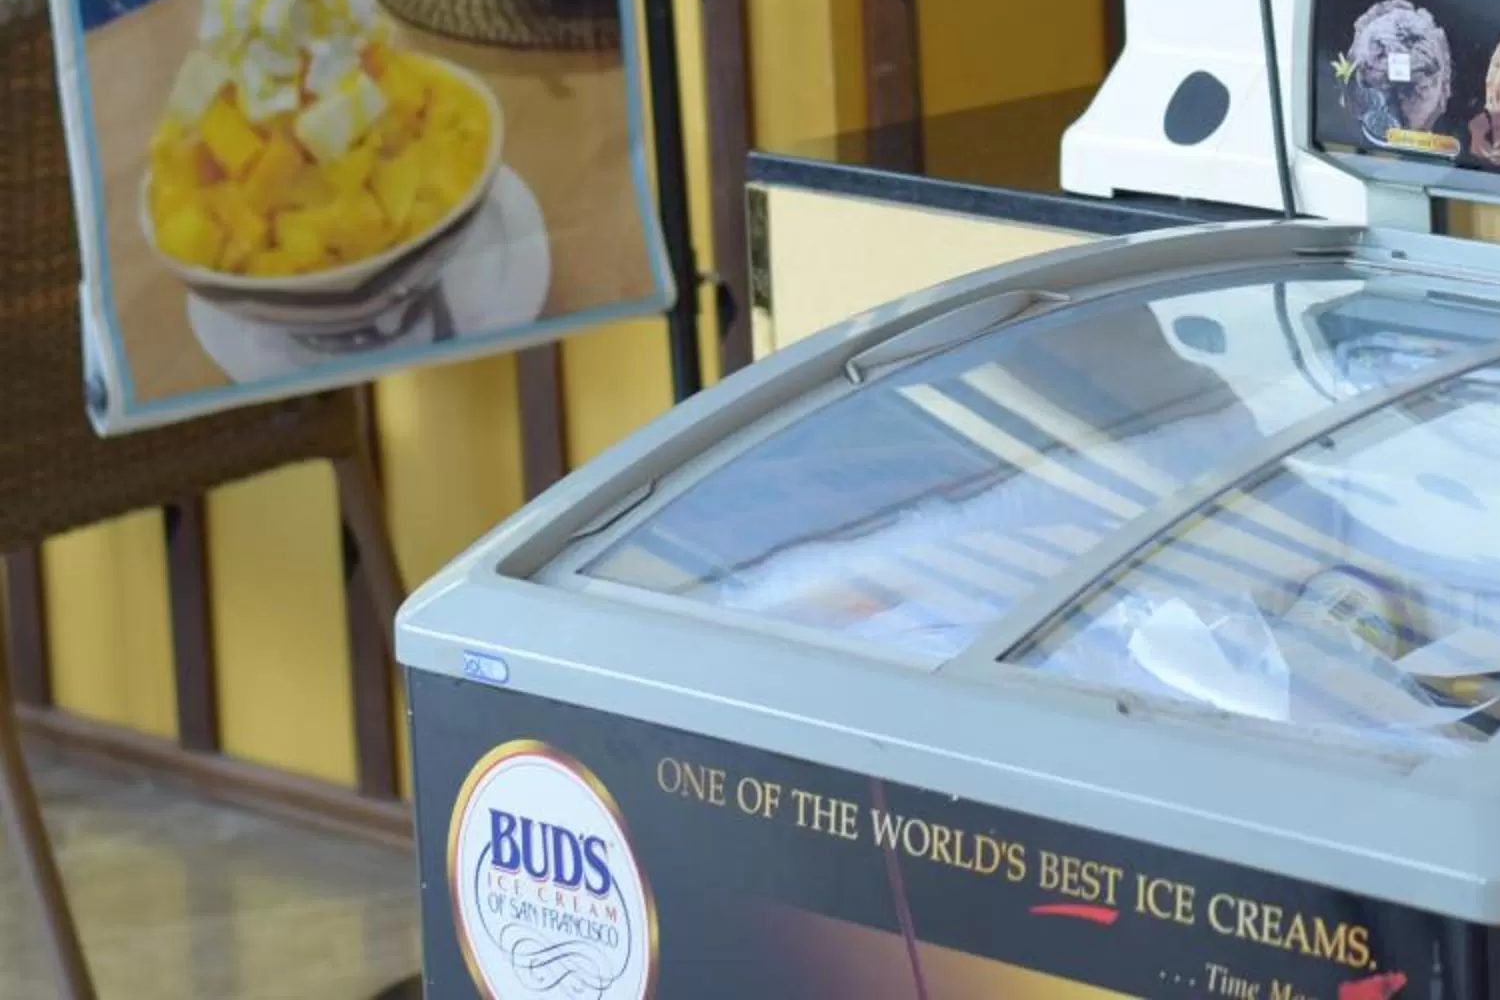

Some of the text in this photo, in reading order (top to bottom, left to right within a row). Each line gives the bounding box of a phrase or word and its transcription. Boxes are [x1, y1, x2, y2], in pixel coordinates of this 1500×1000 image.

[488, 808, 612, 898] BUD'S
[656, 756, 1378, 971] ONE OF THE WORLD'S BEST ICE CREAMS.
[486, 872, 619, 923] ICE CREAM
[487, 889, 620, 950] OF SAN FRANCISCO
